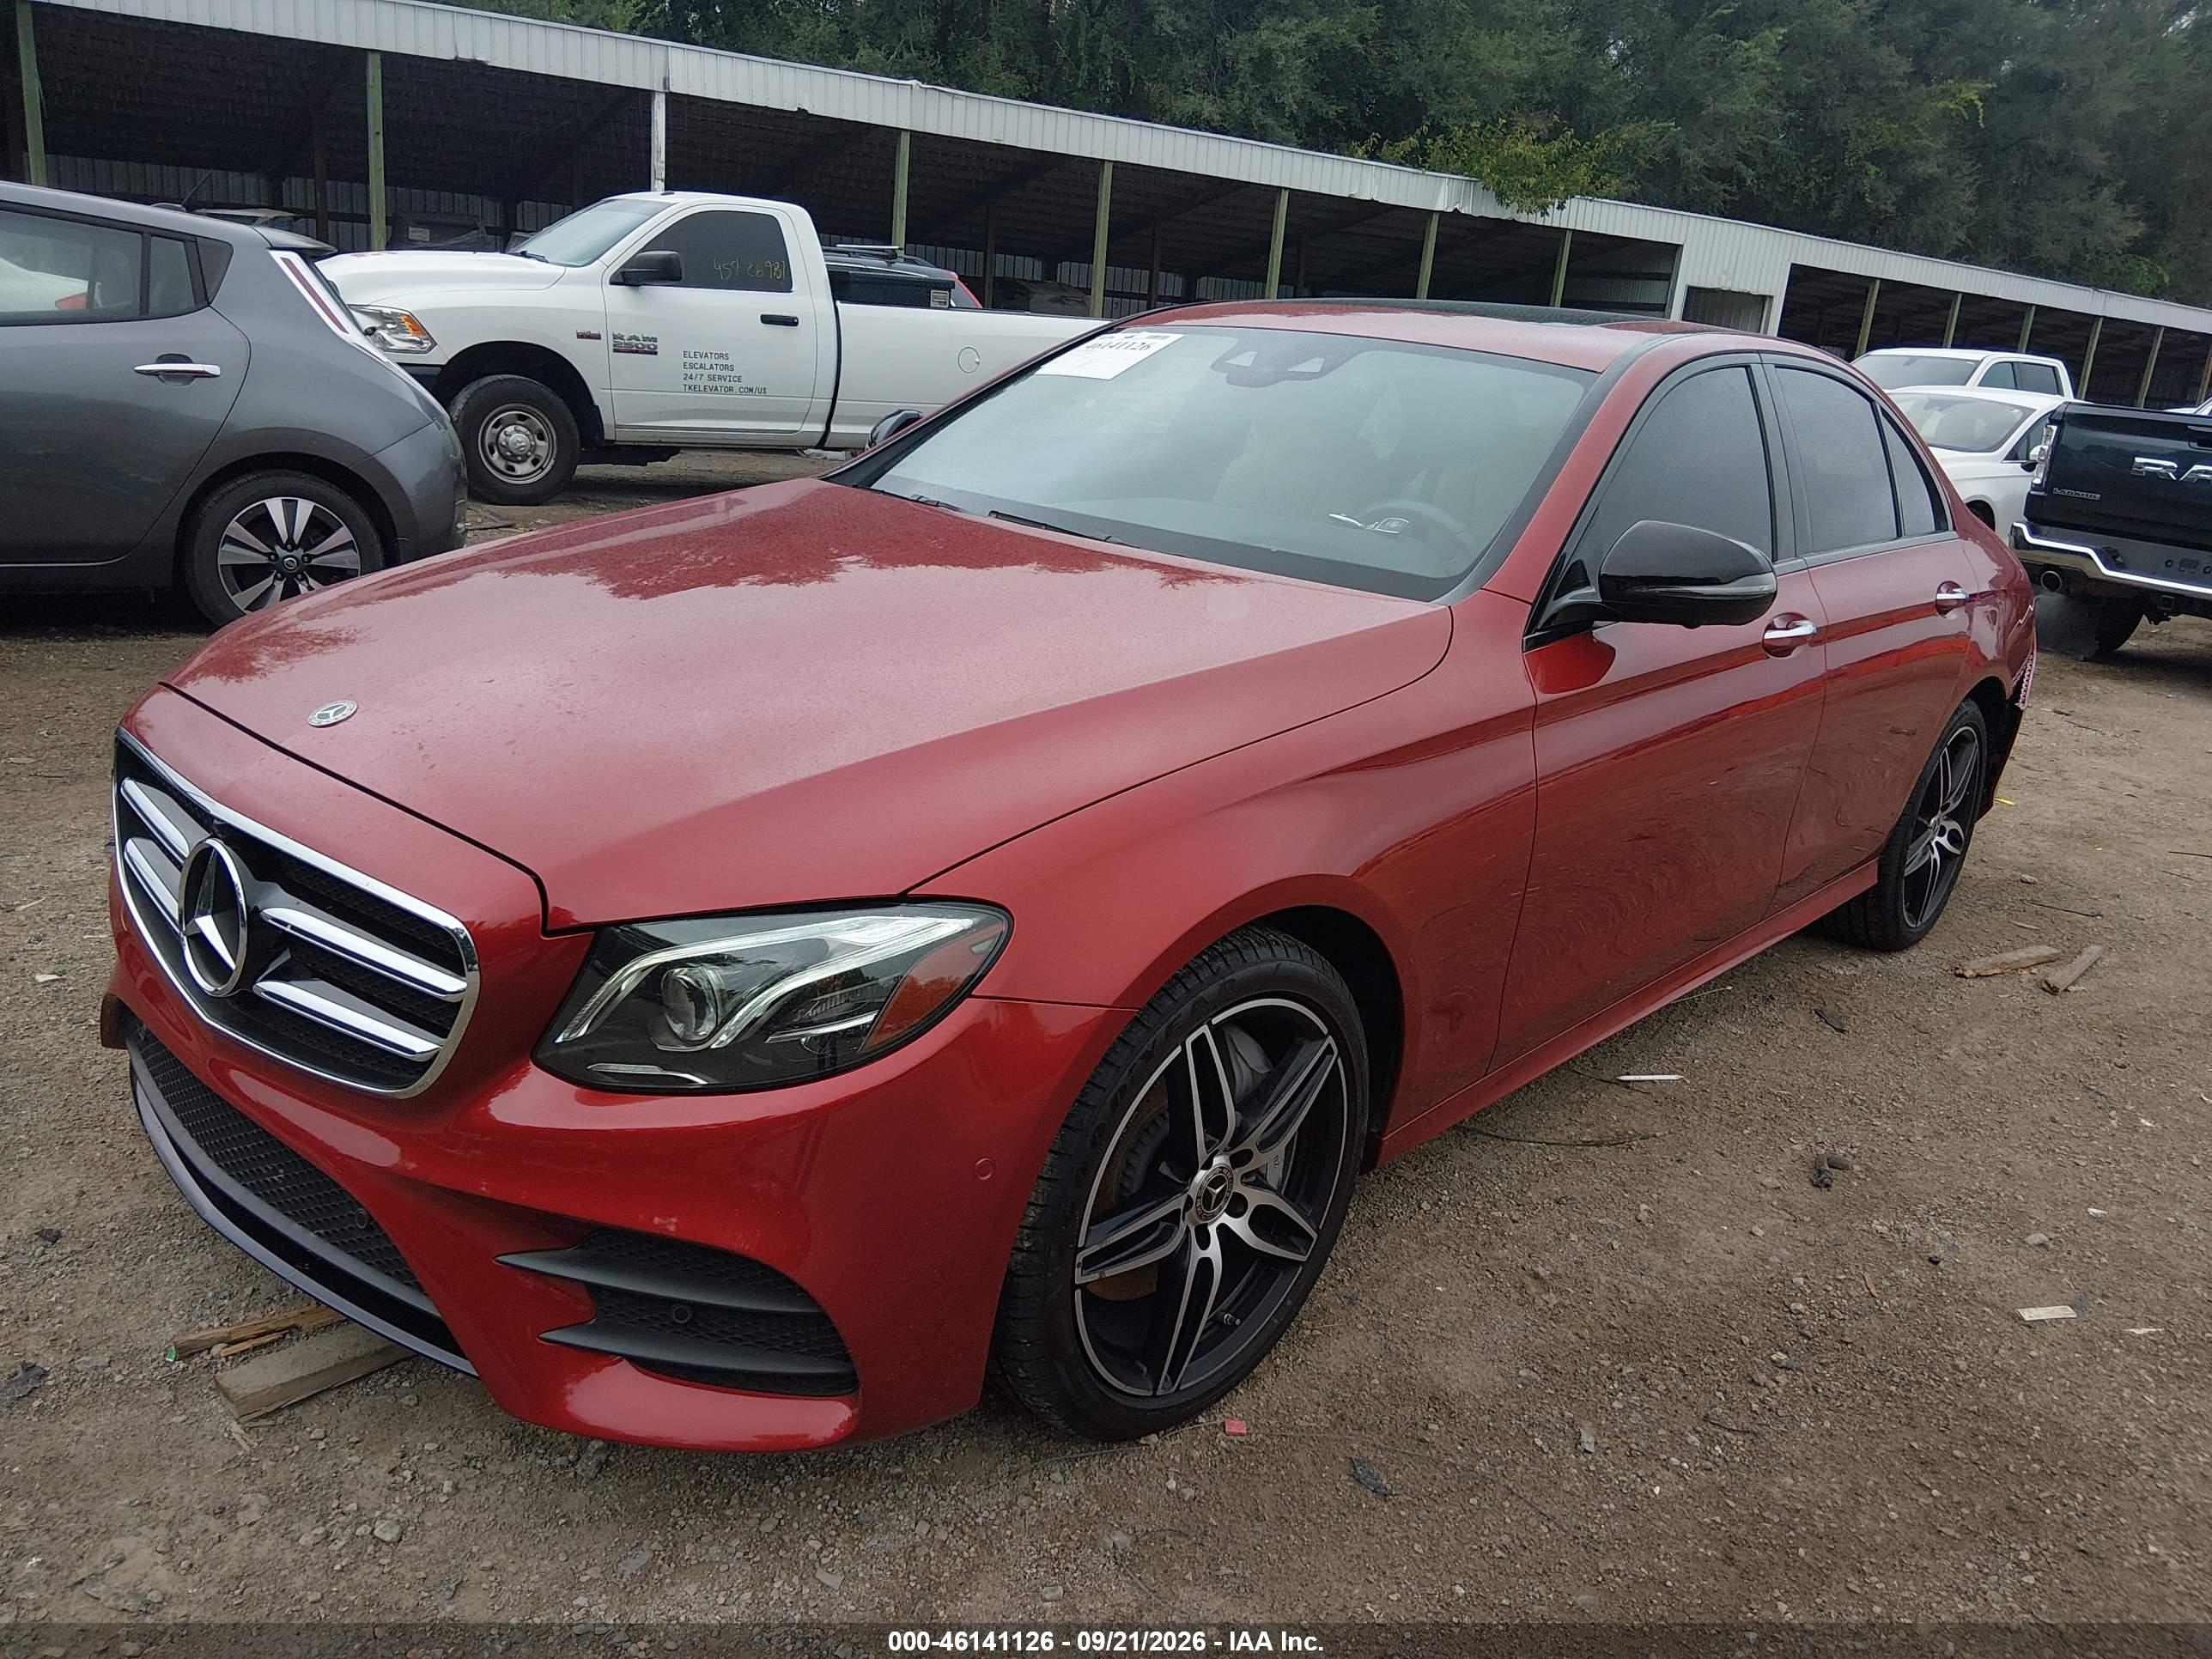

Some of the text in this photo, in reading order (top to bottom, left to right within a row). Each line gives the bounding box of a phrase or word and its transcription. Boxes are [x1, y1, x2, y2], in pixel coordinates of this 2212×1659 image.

[612, 332, 658, 343] RAM
[612, 341, 658, 350] 2500
[683, 350, 730, 361] ELEVATORS
[683, 362, 735, 372] ESCALATORS
[683, 373, 743, 383] 24/7 SERVICE
[683, 384, 767, 395] TKELEVATOR.COM/US
